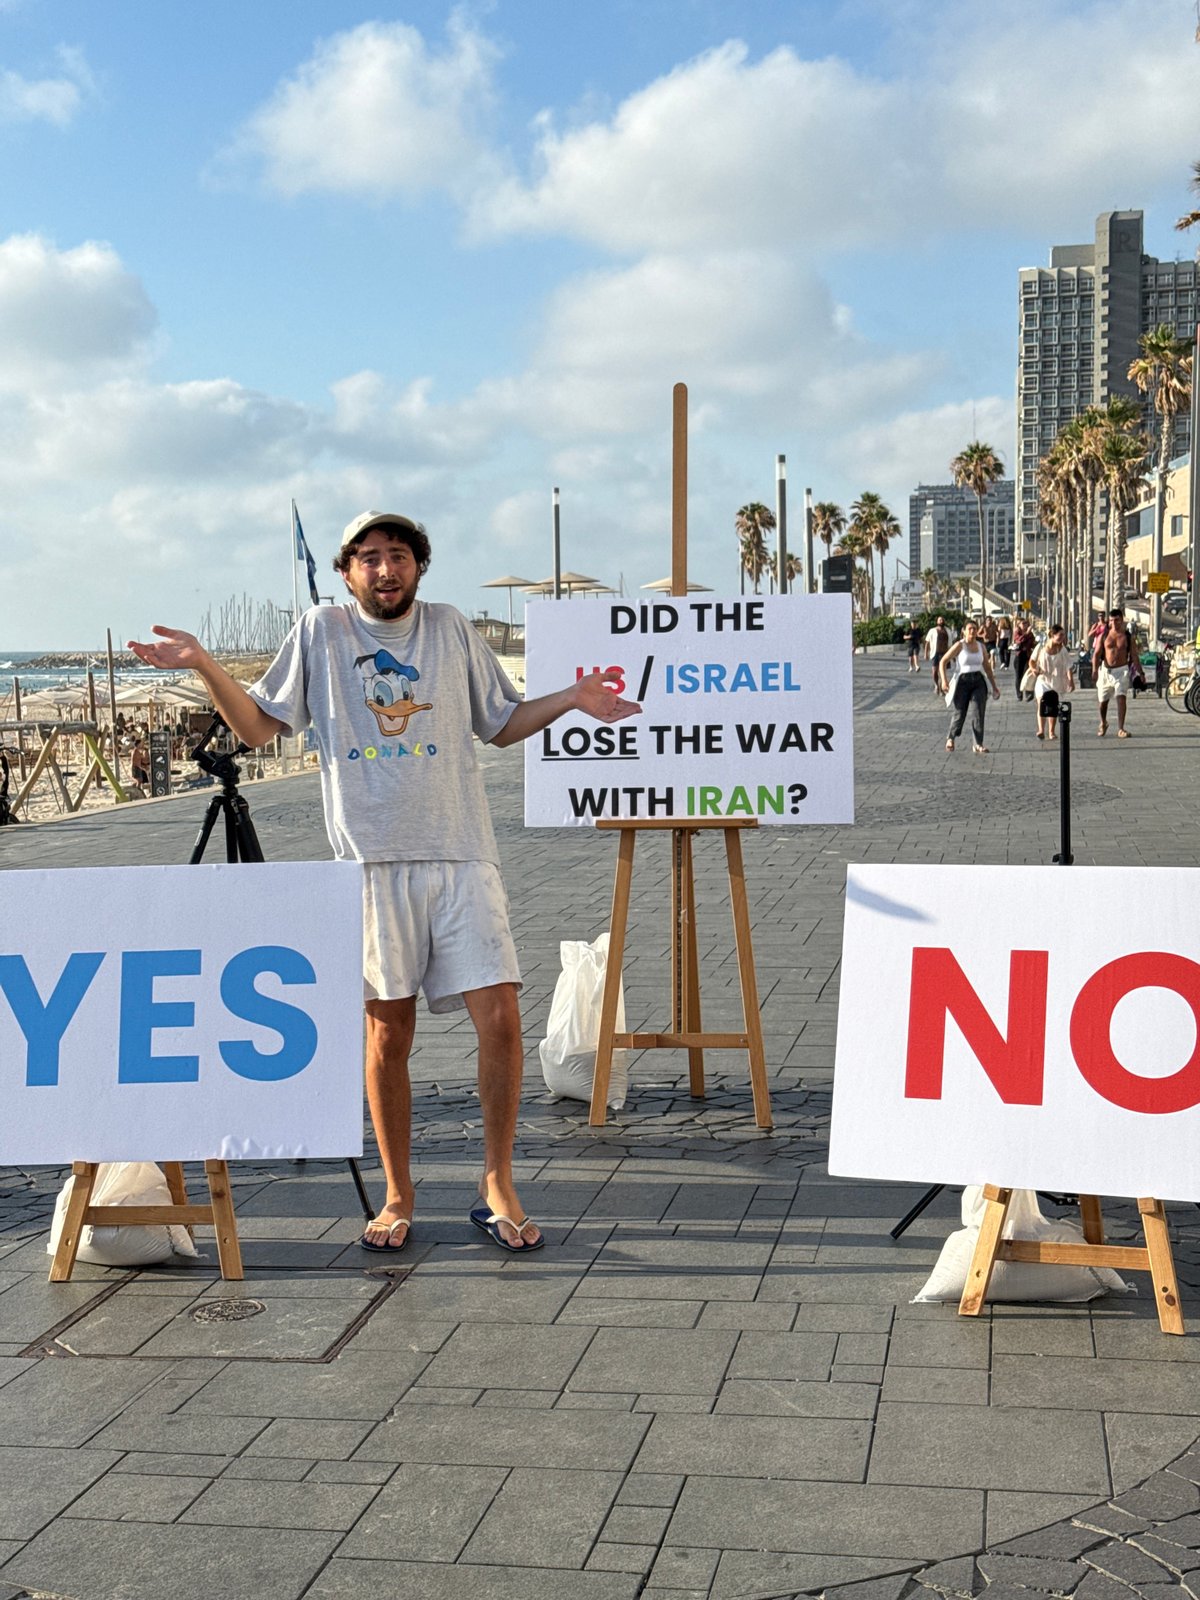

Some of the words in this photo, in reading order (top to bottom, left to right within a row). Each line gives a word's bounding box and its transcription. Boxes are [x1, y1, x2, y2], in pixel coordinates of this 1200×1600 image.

[611, 605, 679, 634] DID
[690, 602, 765, 632] THE
[637, 655, 654, 701] /
[666, 662, 801, 693] ISRAEL
[347, 743, 438, 760] DONALD
[542, 726, 638, 757] LOSE
[649, 725, 724, 754] THE
[735, 722, 835, 752] WAR
[568, 787, 674, 817] WITH
[687, 783, 808, 816] IRAN?
[0, 945, 318, 1086] YES
[905, 946, 1200, 1114] NO
